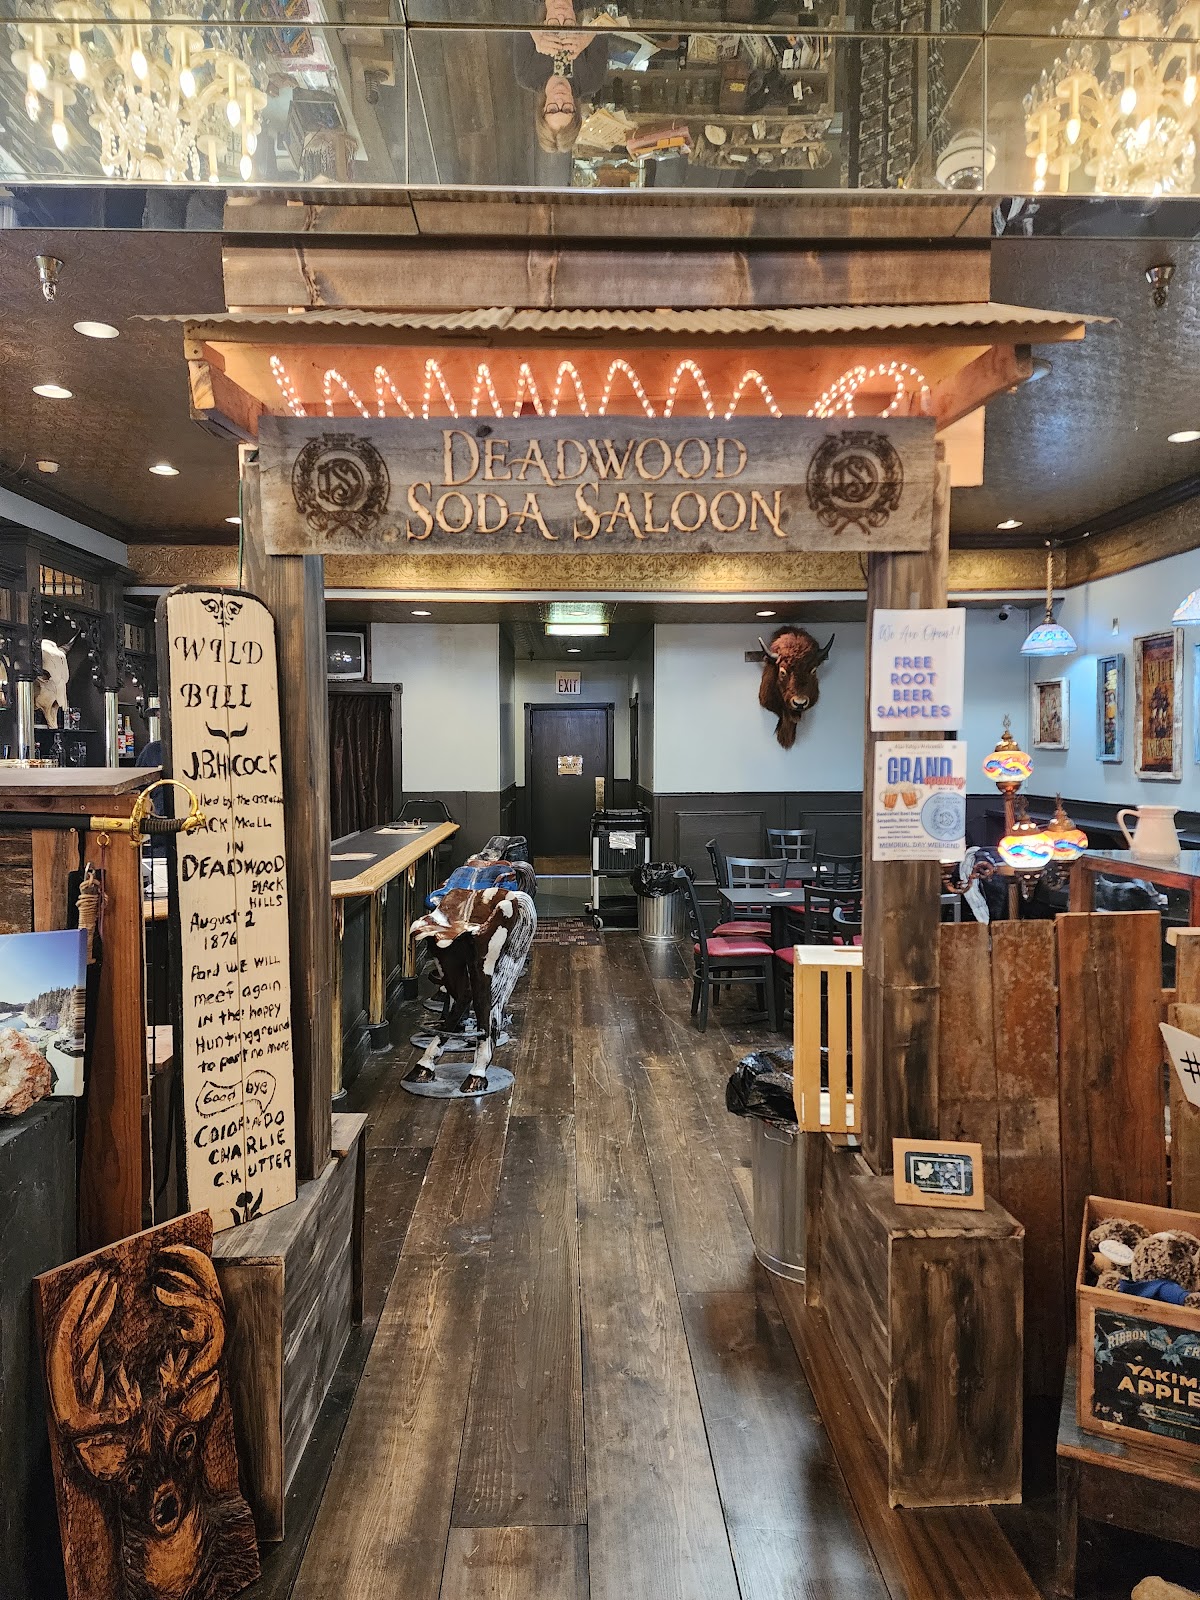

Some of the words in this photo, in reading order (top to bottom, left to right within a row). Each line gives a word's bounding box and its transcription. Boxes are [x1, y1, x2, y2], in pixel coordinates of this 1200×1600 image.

[441, 428, 748, 486] DEADWOOD
[406, 481, 559, 540] SODA
[573, 481, 789, 541] SALOON
[174, 636, 263, 665] WILD
[894, 656, 932, 669] FREE
[558, 678, 578, 693] EXIT
[890, 672, 936, 685] ROOT
[180, 683, 252, 710] BILL
[892, 689, 932, 702] BEER
[877, 705, 951, 718] SAMPLES
[887, 756, 954, 785] GRAND
[227, 841, 244, 854] IN
[182, 855, 285, 882] DEADWOOD
[250, 895, 283, 910] HILLS
[190, 909, 239, 932] August
[204, 931, 238, 950] 1876
[254, 955, 280, 969] WILL
[242, 980, 281, 999] again
[198, 1058, 216, 1073] to
[208, 1128, 286, 1165] CHARLIE
[1107, 1330, 1148, 1349] RIBBON
[1126, 1362, 1200, 1389] YAKIM
